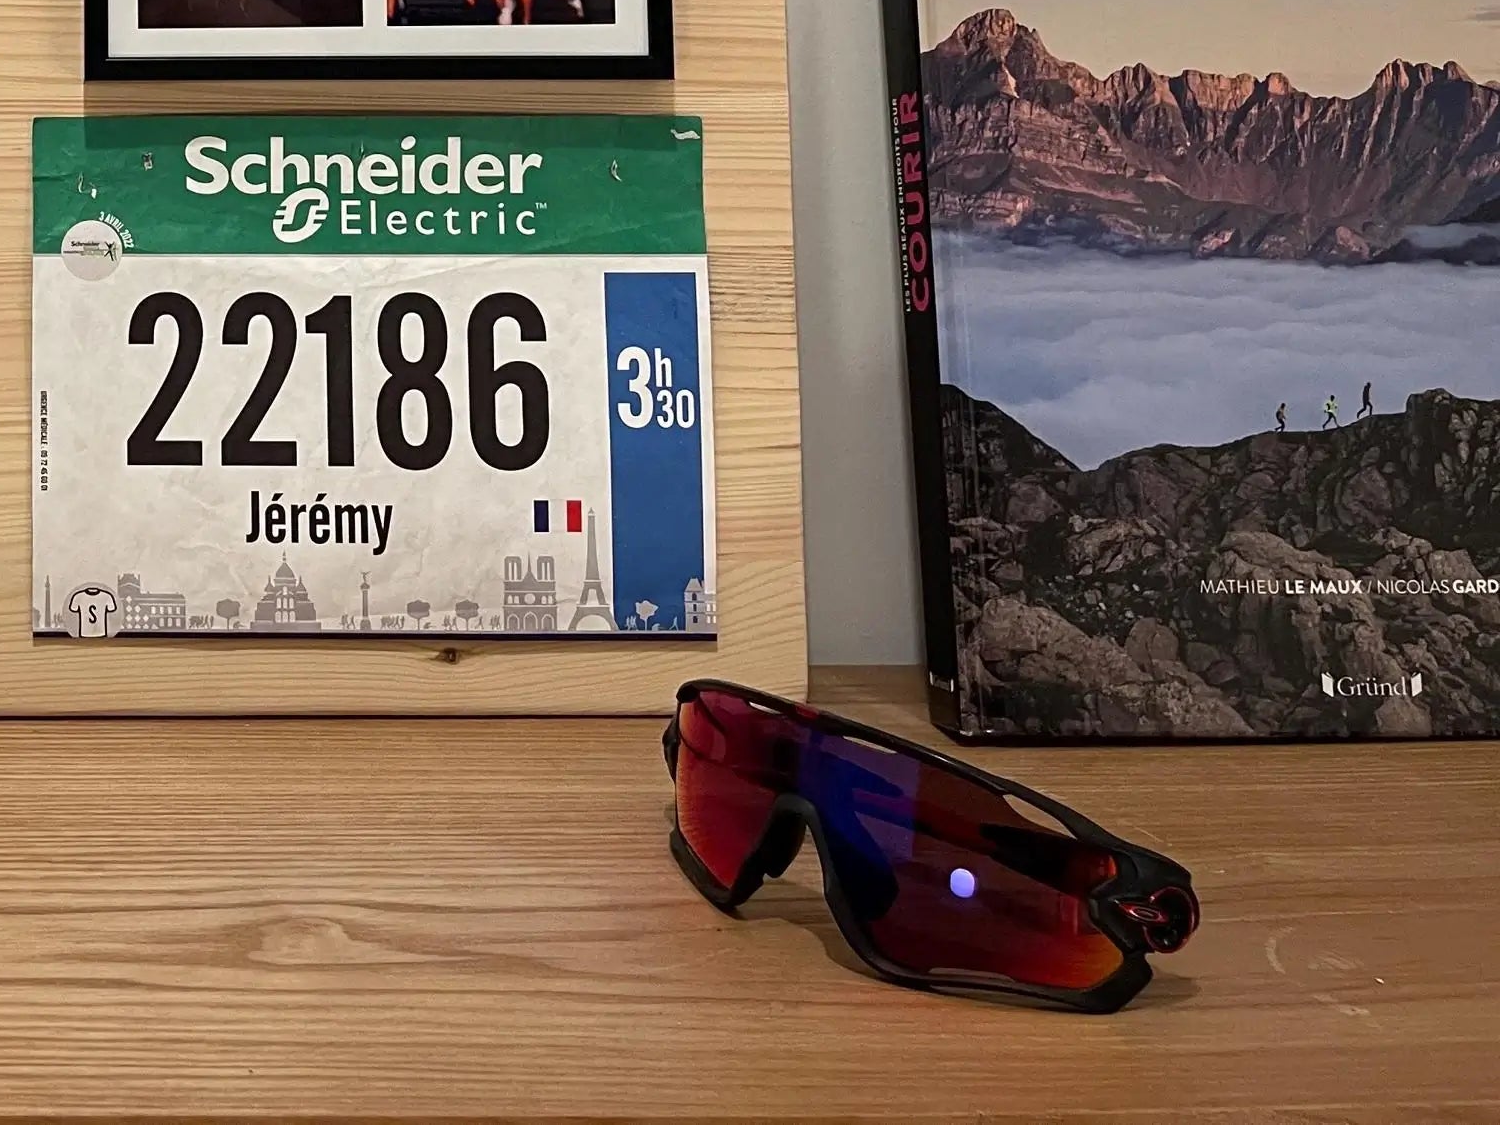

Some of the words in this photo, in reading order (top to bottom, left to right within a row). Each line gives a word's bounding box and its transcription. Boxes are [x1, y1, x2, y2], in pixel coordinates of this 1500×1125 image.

[891, 98, 900, 133] POUR
[184, 136, 543, 195] Schneider
[894, 138, 905, 204] ENDROITS
[900, 91, 930, 311] COURIR
[99, 211, 105, 221] 3
[104, 213, 124, 232] AVRIL
[120, 229, 134, 248] 2022
[900, 207, 908, 250] BEAUX
[127, 291, 550, 472] 22186
[246, 489, 394, 556] Jérémy
[1200, 579, 1279, 595] MATHIEU
[1284, 579, 1305, 595] LE
[1310, 579, 1363, 595] MAUX
[1377, 579, 1450, 594] NICOLAS
[1452, 578, 1500, 594] GARD
[89, 605, 97, 623] S
[1336, 675, 1407, 697] Gründ
